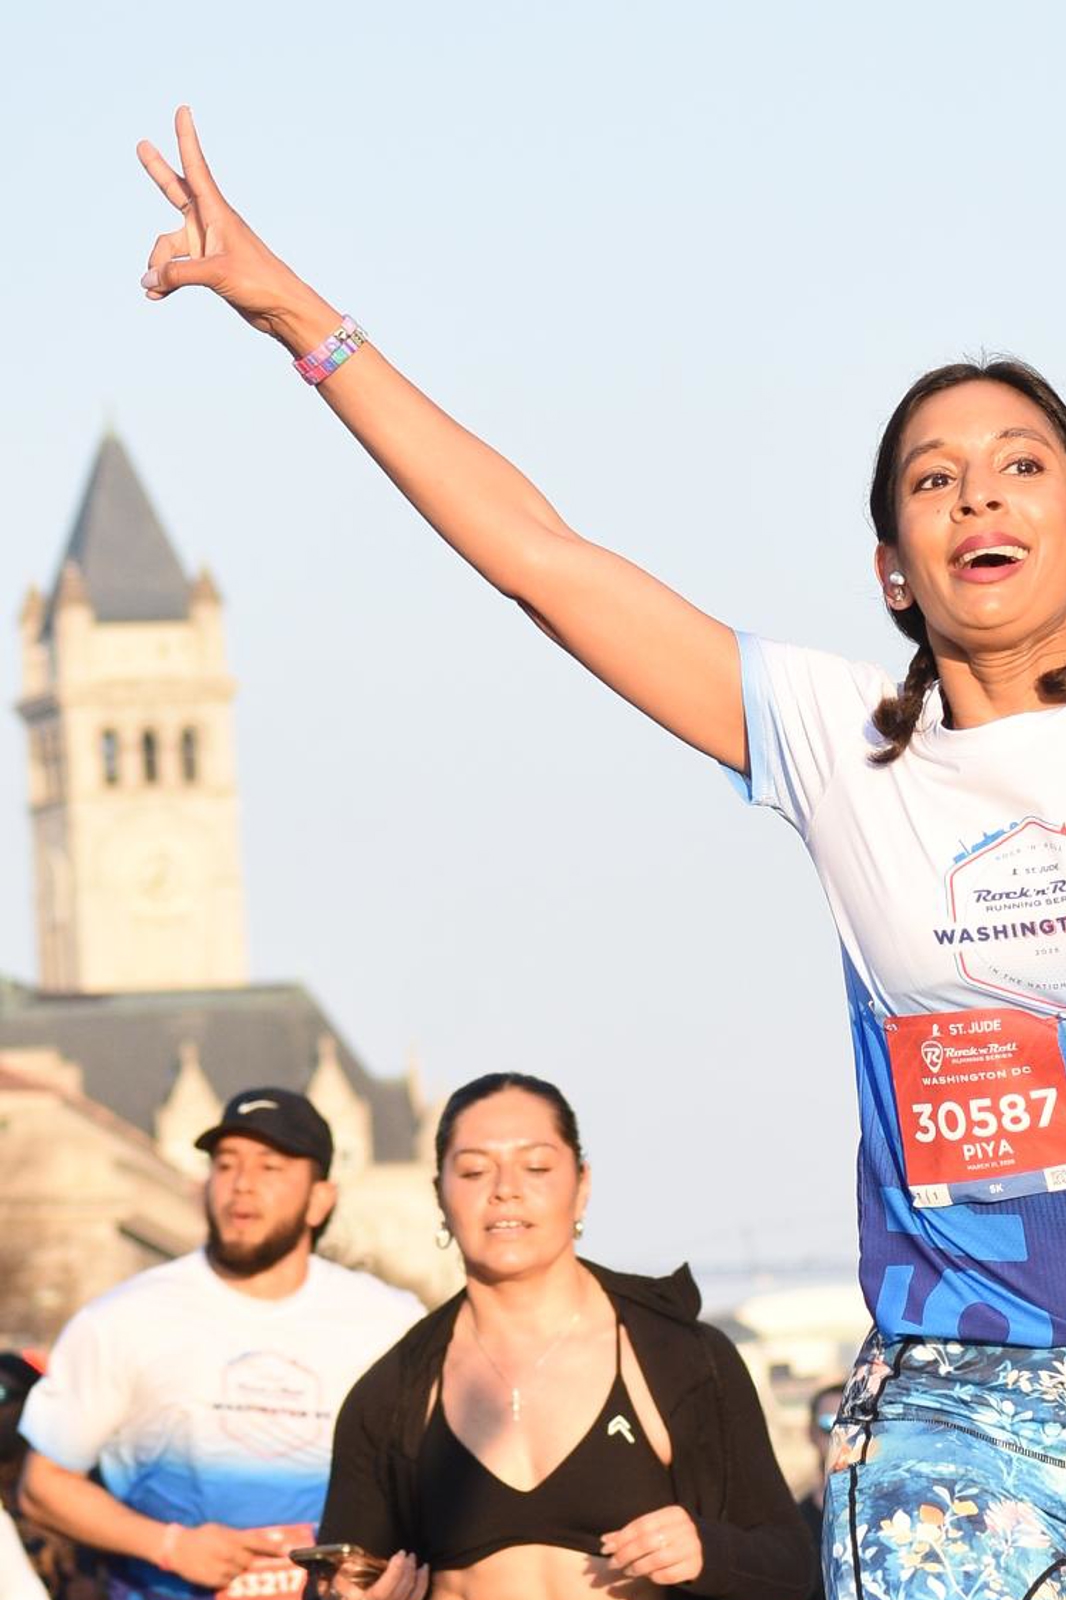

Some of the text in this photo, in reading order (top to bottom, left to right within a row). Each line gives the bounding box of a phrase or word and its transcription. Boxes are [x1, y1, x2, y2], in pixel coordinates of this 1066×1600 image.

[1038, 862, 1060, 874] JUDE
[985, 900, 1042, 914] RUNNING
[1003, 972, 1023, 987] THE
[949, 1019, 1003, 1037] ST. JUDE
[922, 1066, 1033, 1087] WASHINGTON DC
[912, 1087, 1058, 1143] 30587
[962, 1138, 1015, 1162] PIYA
[988, 1182, 1005, 1195] 5K
